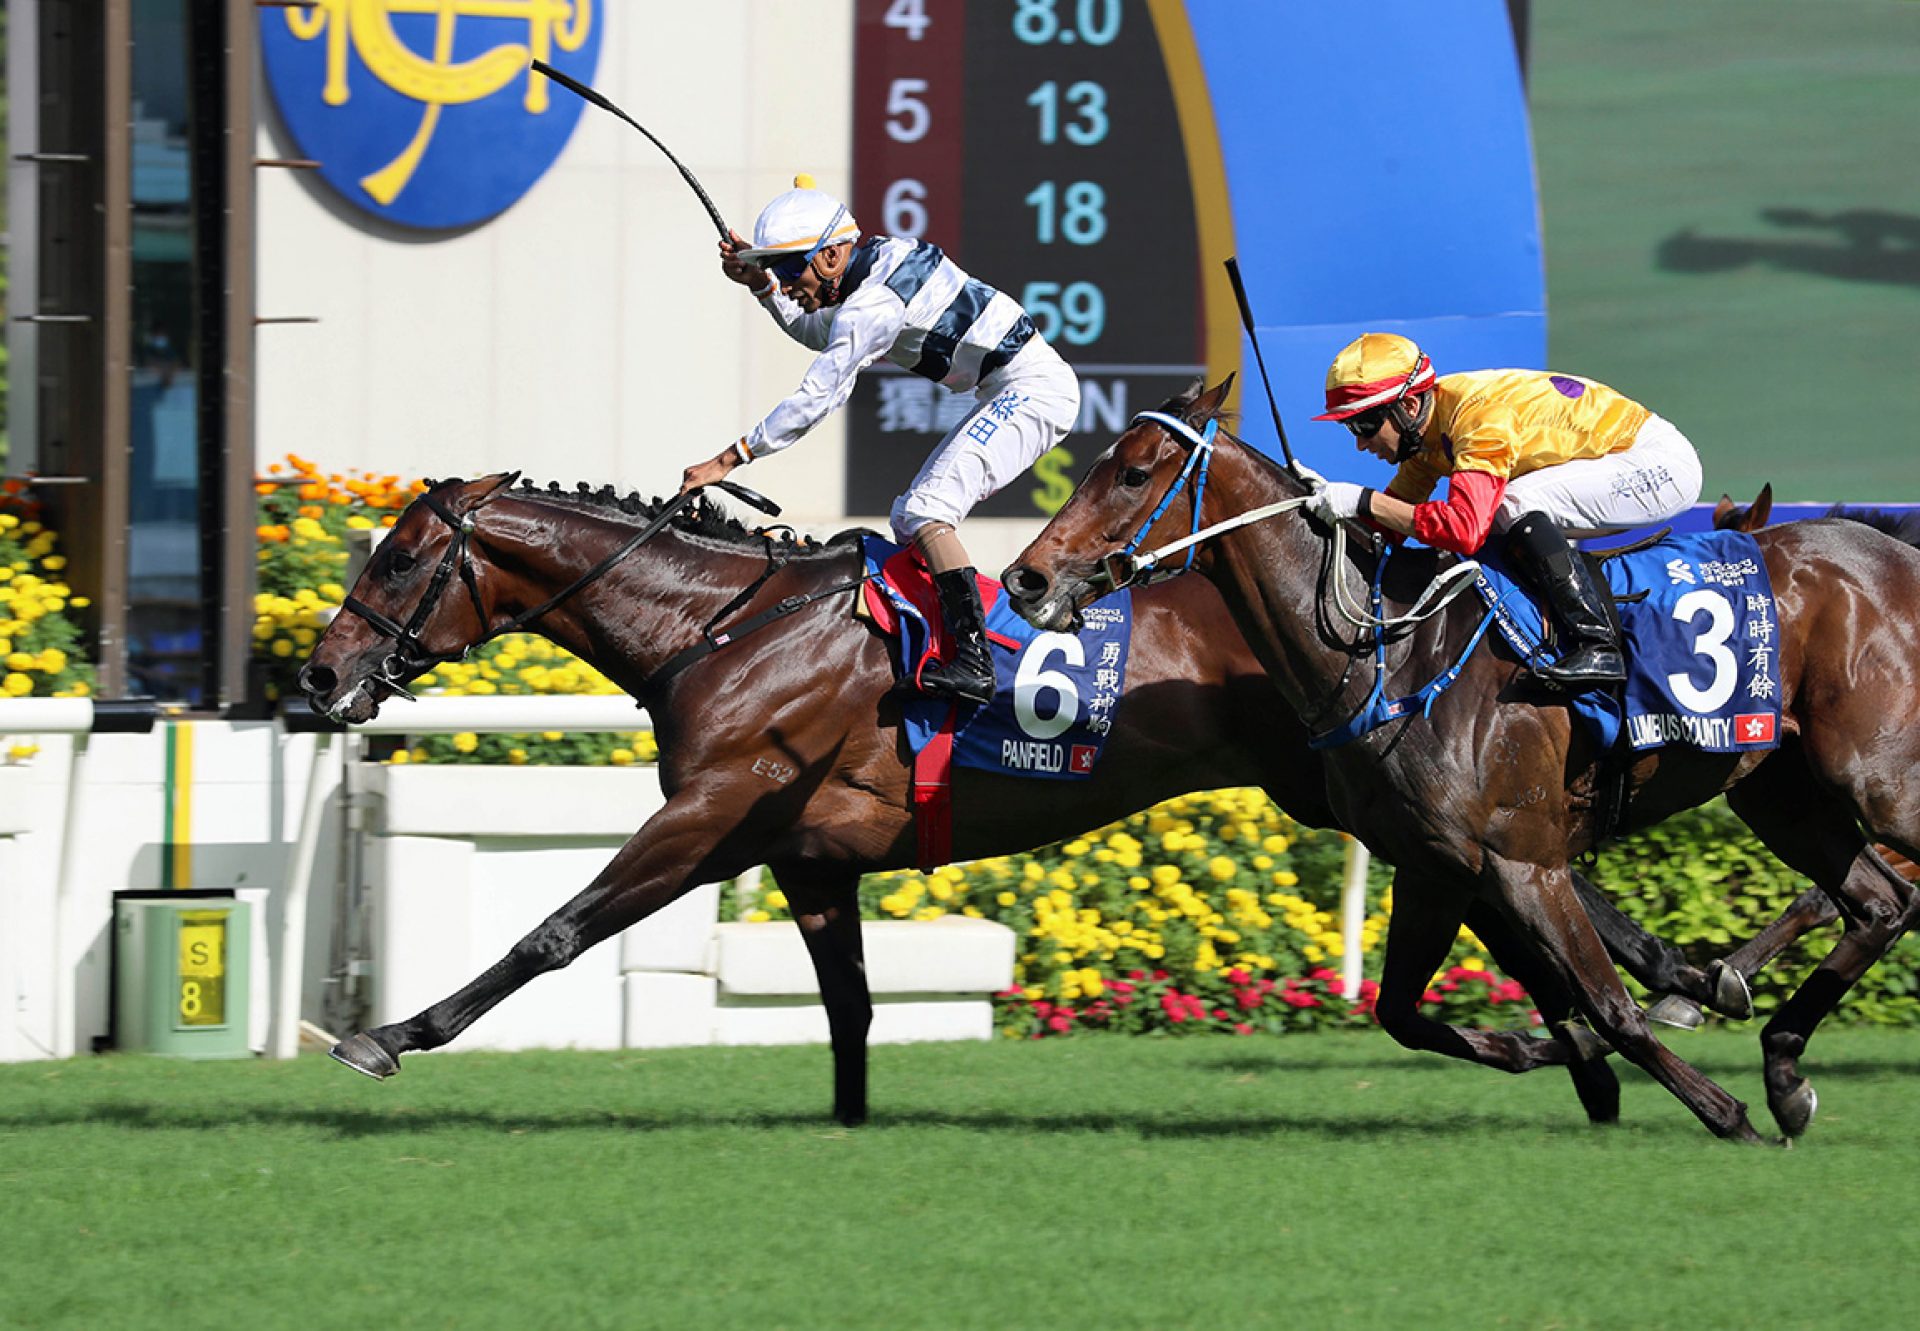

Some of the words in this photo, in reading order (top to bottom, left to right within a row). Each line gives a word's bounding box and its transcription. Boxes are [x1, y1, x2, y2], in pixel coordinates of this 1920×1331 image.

[883, 0, 931, 41] 4
[1013, 0, 1122, 46] 8.0
[884, 78, 931, 143] 5
[1026, 81, 1109, 146] 13
[882, 178, 928, 239] 6
[1025, 181, 1106, 245] 18
[1022, 282, 1106, 345] 59
[1668, 589, 1738, 713] 3
[1745, 593, 1776, 700] 時時有餘
[1014, 631, 1085, 740] 6
[1001, 739, 1064, 773] PANFIELD
[1626, 713, 1681, 747] LUMBUS
[751, 757, 793, 784] E52
[190, 941, 208, 966] S
[181, 981, 201, 1017] 8
